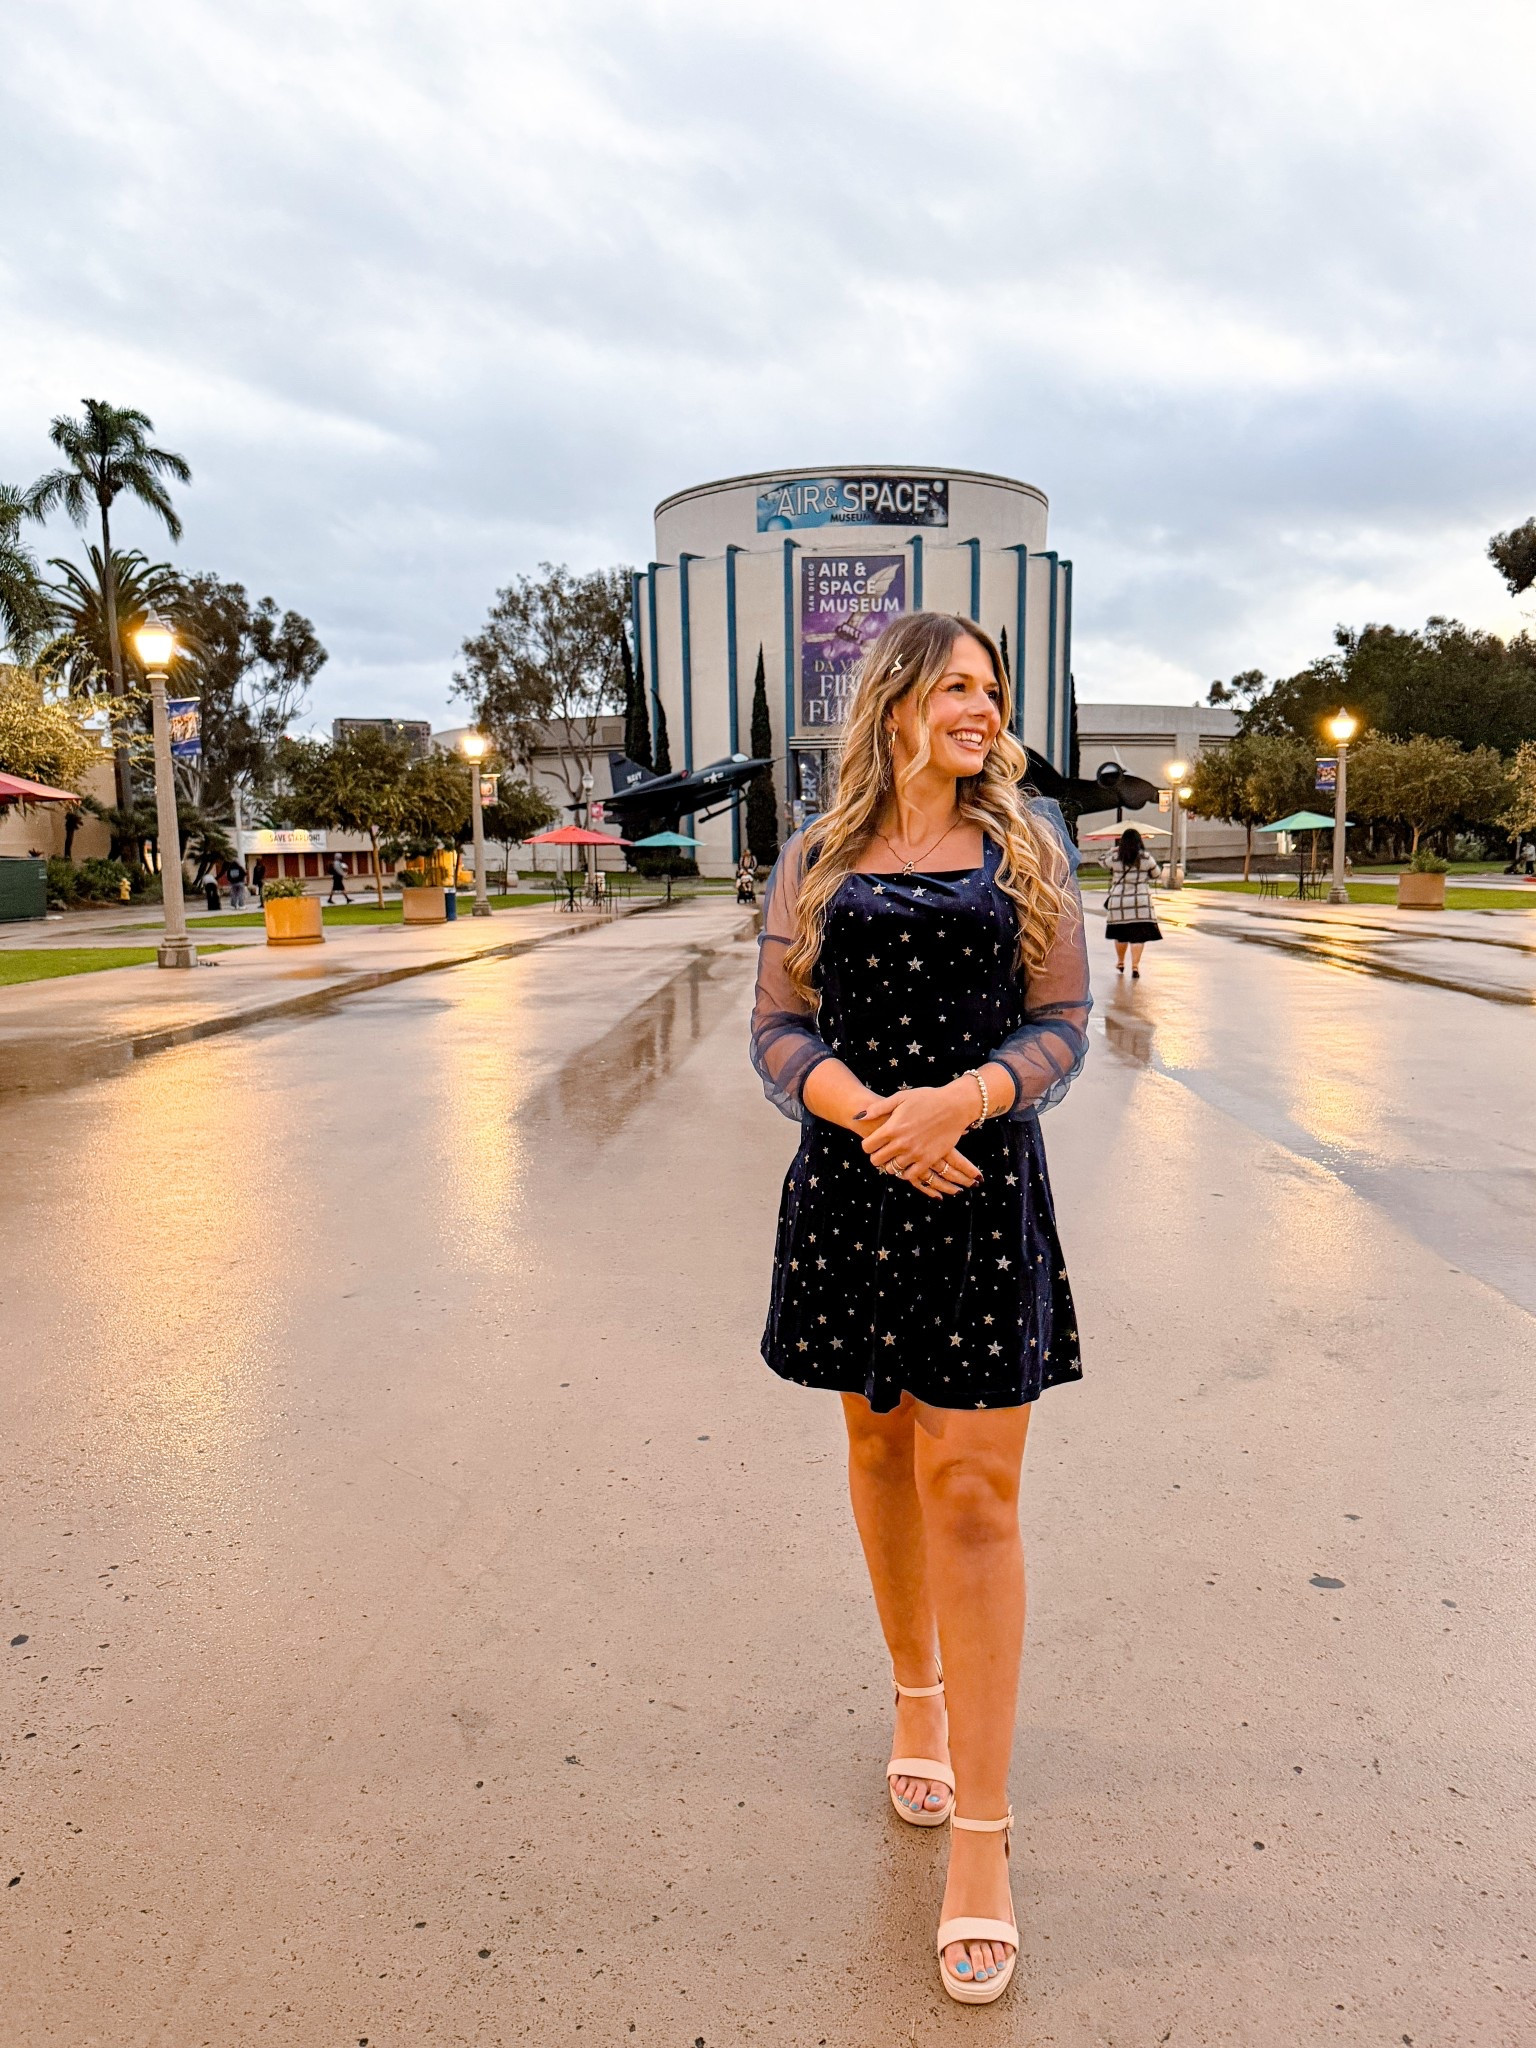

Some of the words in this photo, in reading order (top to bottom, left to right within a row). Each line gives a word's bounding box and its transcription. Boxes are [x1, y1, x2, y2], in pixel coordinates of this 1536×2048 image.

[777, 486, 820, 516] AIR
[824, 486, 838, 509] &
[843, 482, 930, 514] SPACE
[830, 513, 870, 523] MUSEUM
[818, 562, 849, 577] AIR
[854, 562, 867, 577] &
[819, 580, 877, 596] SPACE
[819, 598, 900, 614] MUSEUM
[814, 660, 835, 673] DA
[269, 834, 286, 843] SAVE
